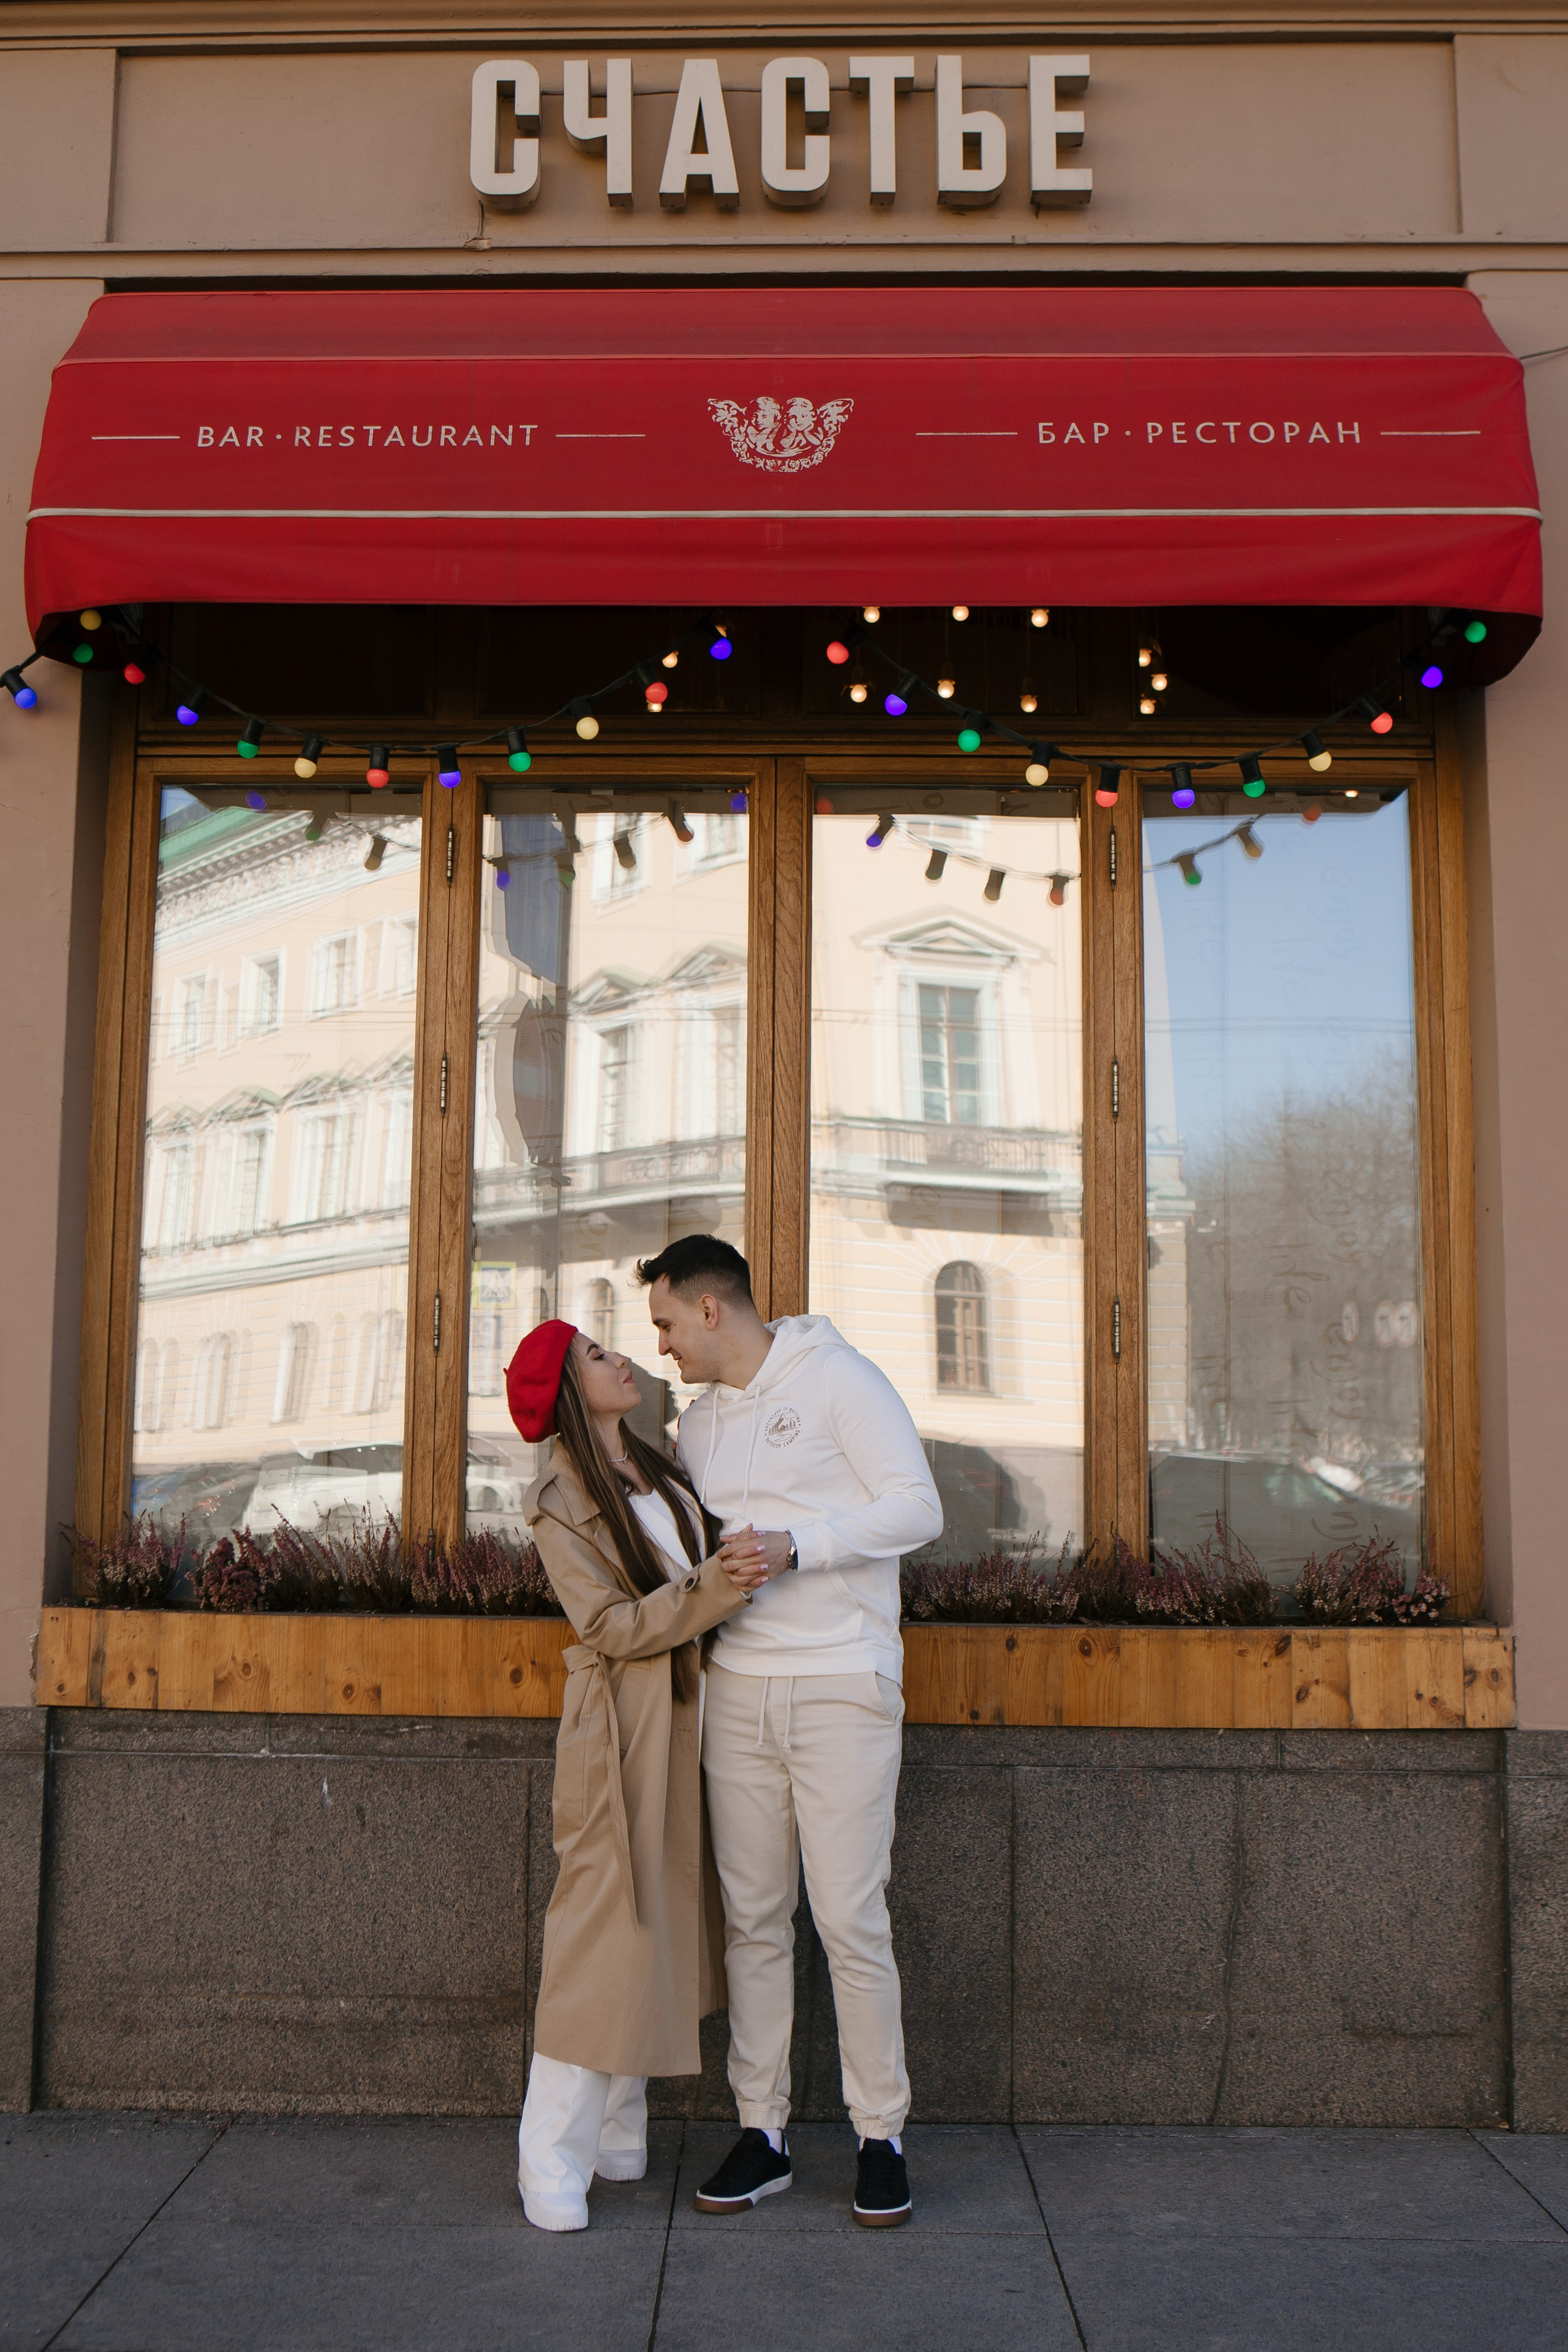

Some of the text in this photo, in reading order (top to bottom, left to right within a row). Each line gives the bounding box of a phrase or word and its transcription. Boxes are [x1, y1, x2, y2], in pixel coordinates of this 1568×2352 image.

[469, 54, 1093, 206] СЧАСТЬЕ
[197, 424, 539, 448] BAR RESTAURANT
[1038, 421, 1361, 445] БАР РЕСТОРАН
[765, 1429, 801, 1449] OUTDOOR CAMPING
